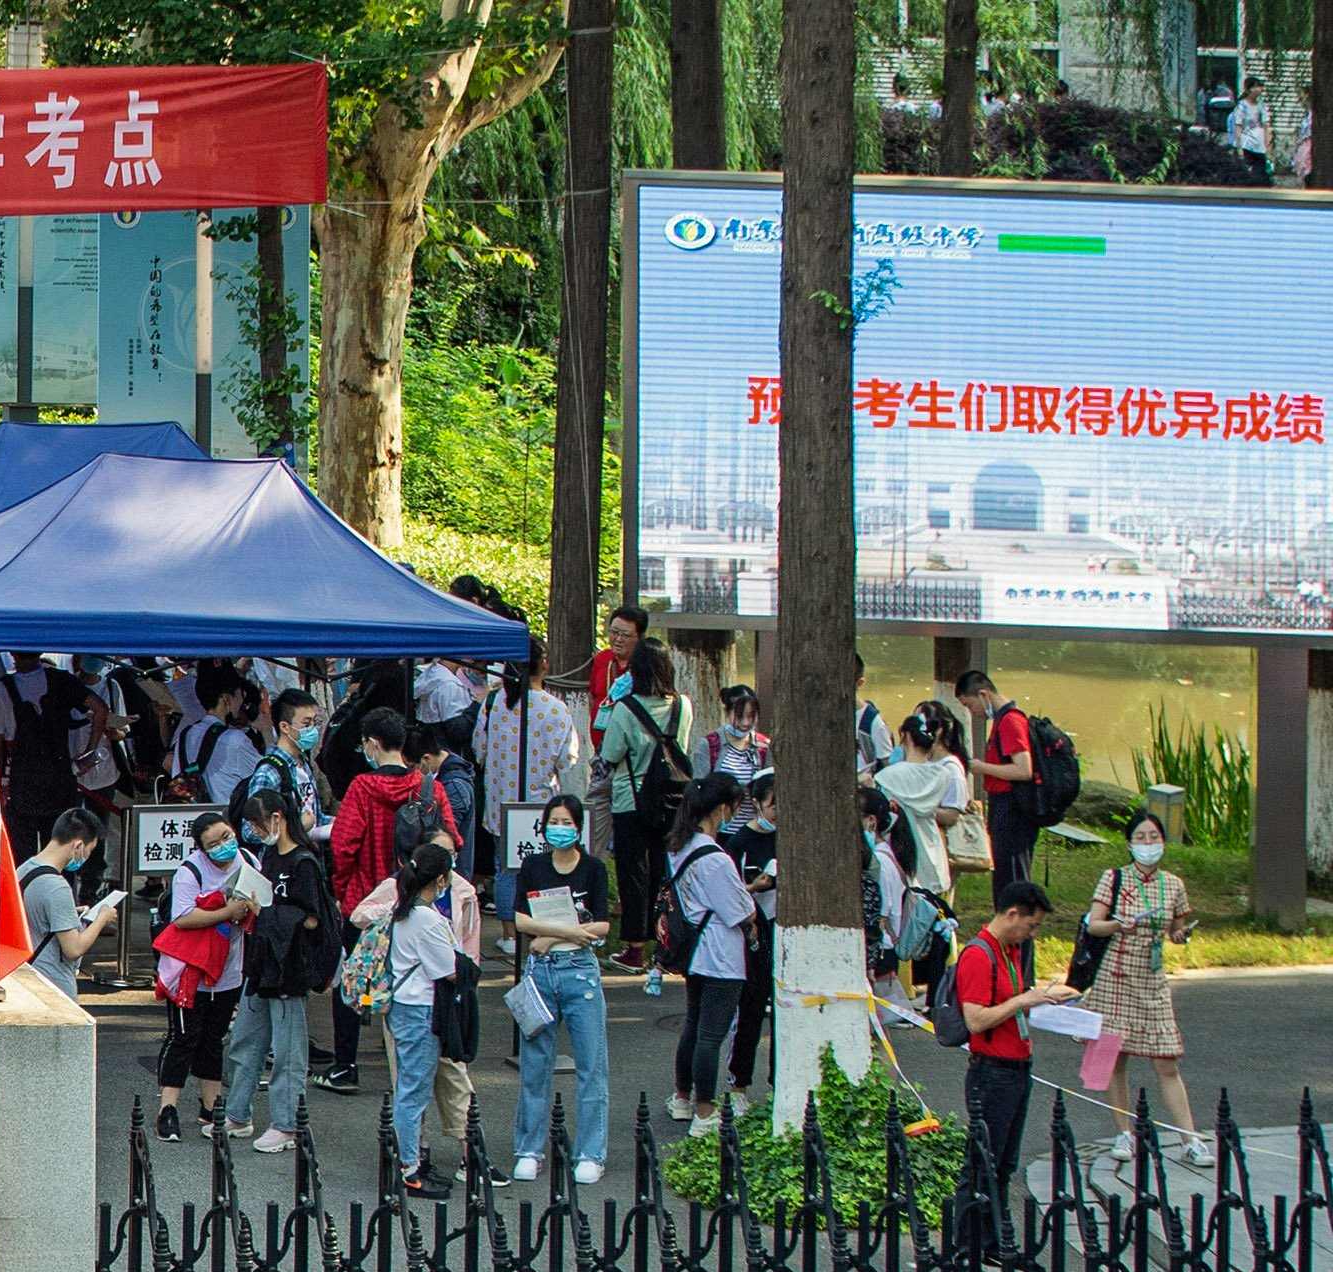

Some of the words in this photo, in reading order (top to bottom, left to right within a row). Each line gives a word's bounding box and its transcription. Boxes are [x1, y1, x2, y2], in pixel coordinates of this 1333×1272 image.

[722, 216, 983, 249] 南京高级中学
[747, 376, 1325, 444] 预考生们取得优异成绩
